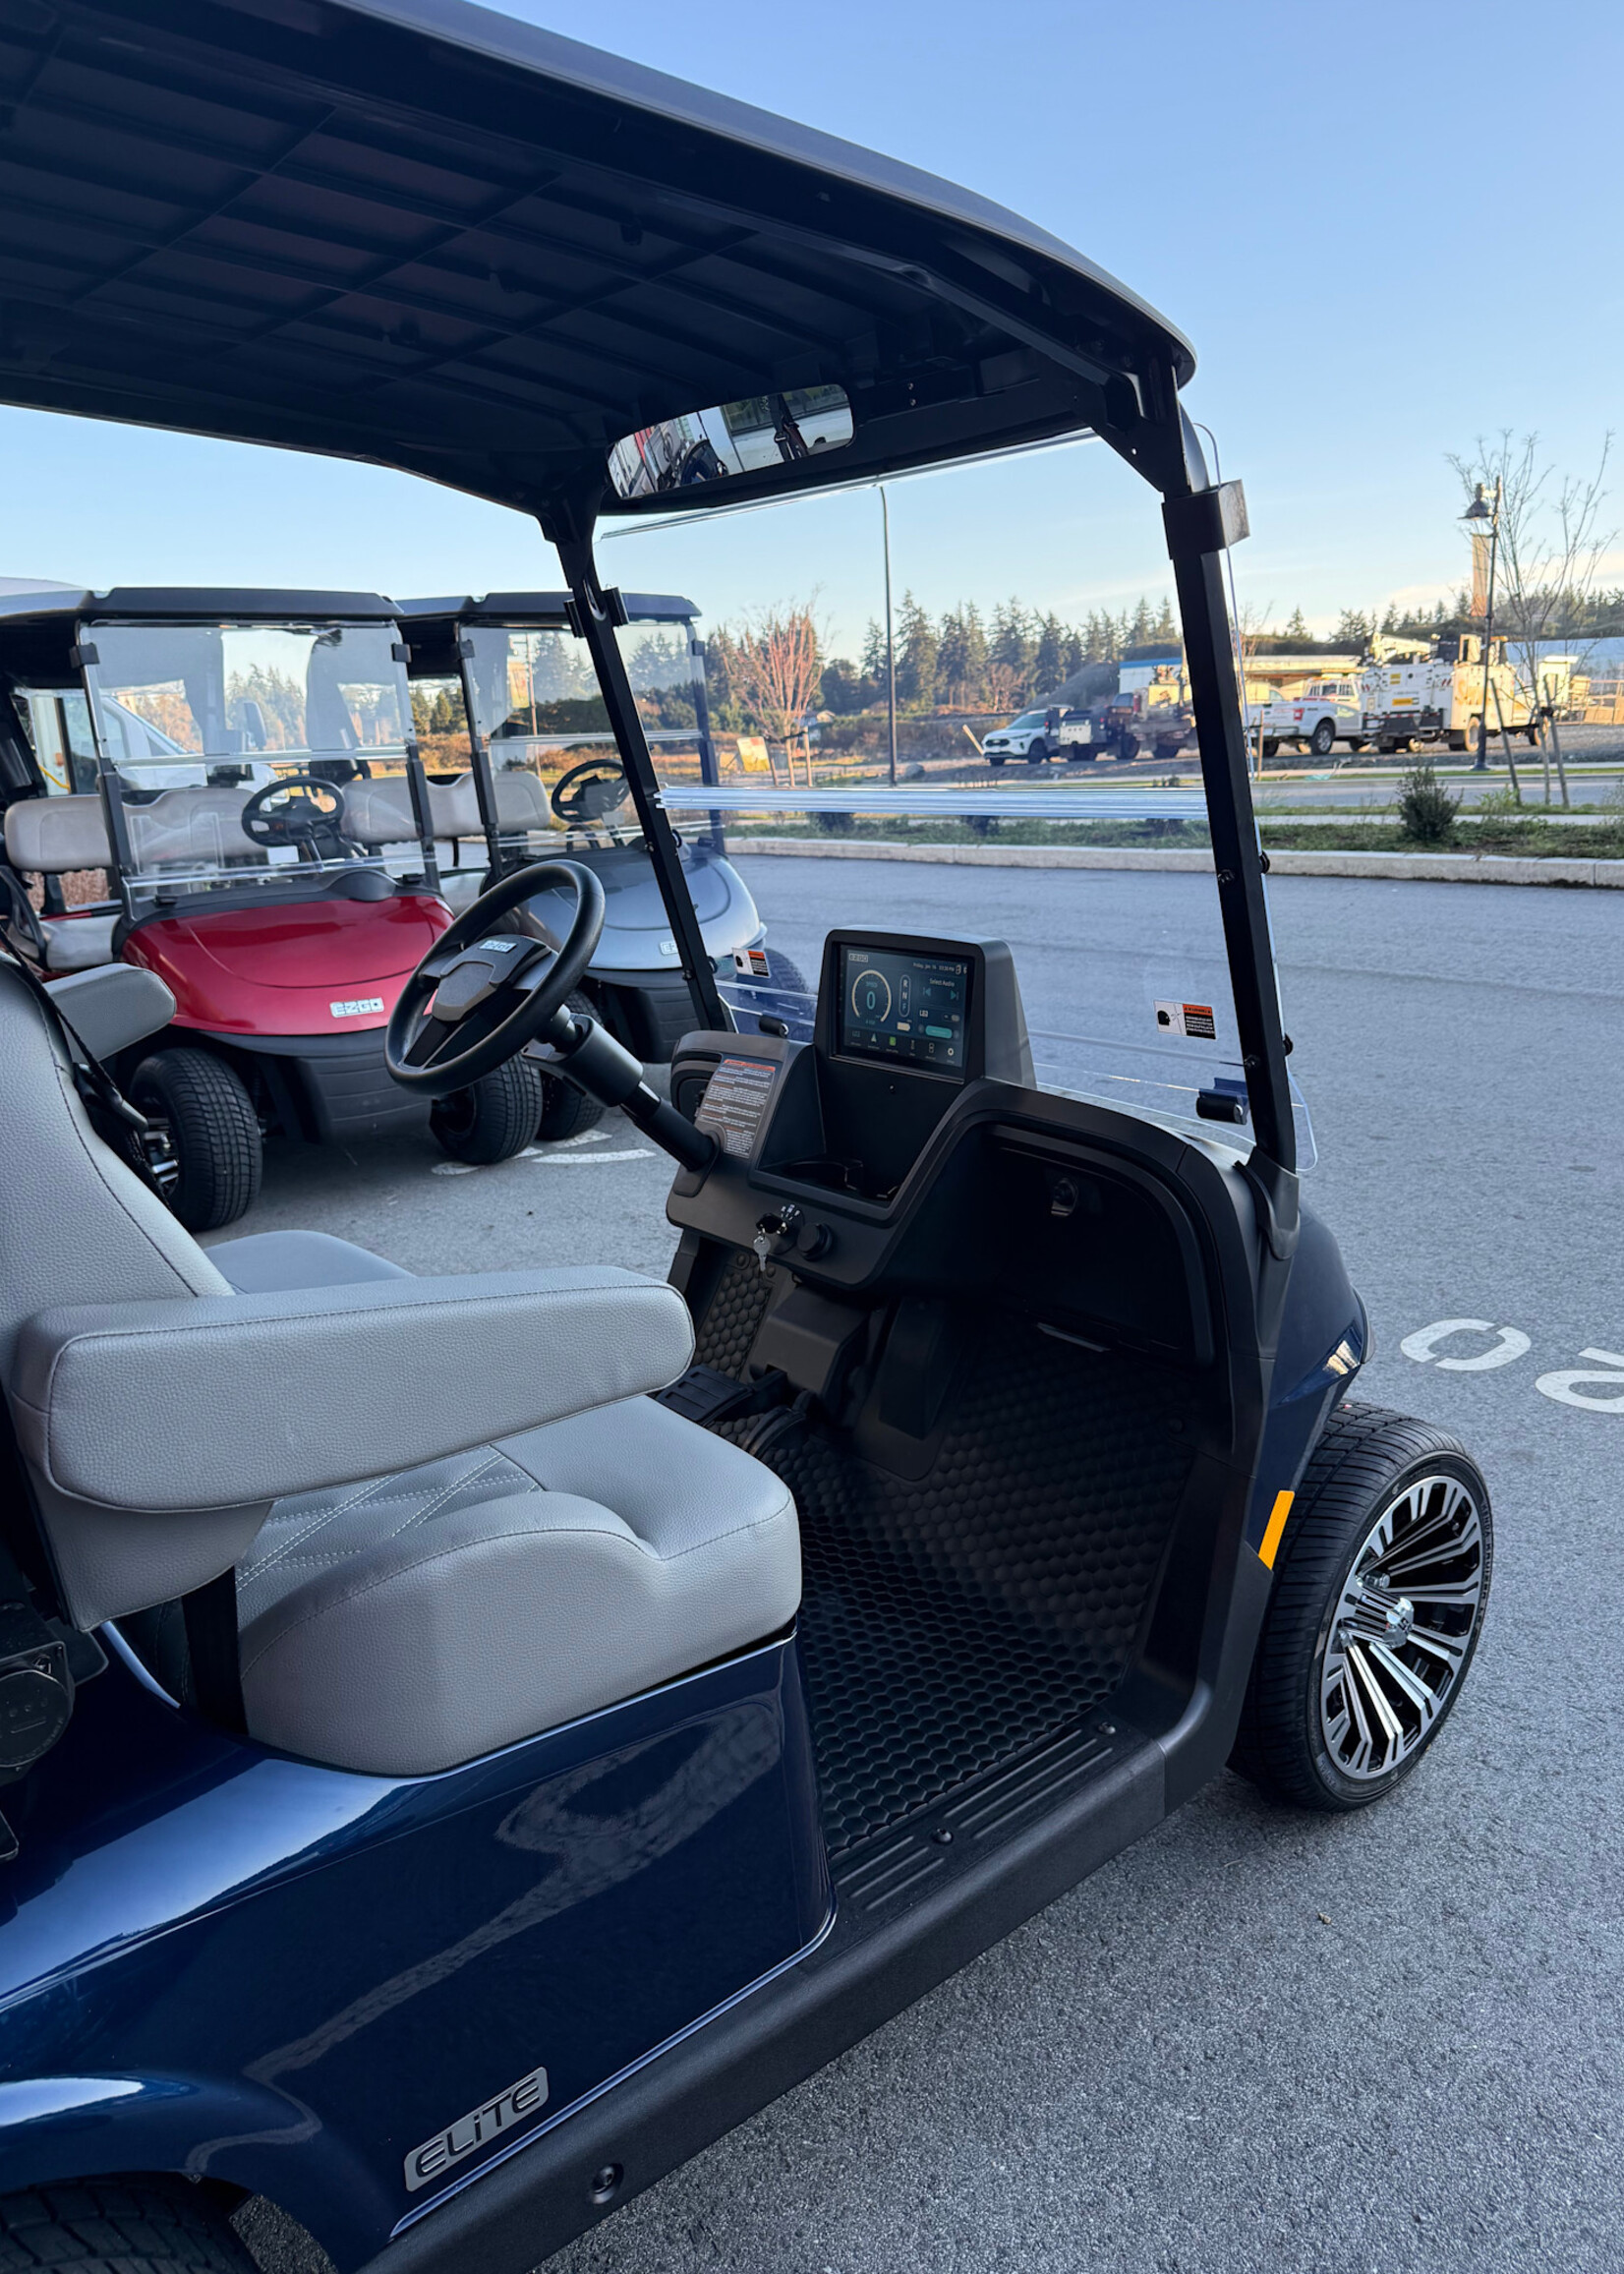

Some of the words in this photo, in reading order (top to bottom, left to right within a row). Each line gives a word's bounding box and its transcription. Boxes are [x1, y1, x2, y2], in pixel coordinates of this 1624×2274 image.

[902, 979, 908, 988] R
[330, 998, 384, 1018] EZGO
[866, 991, 876, 1010] 0
